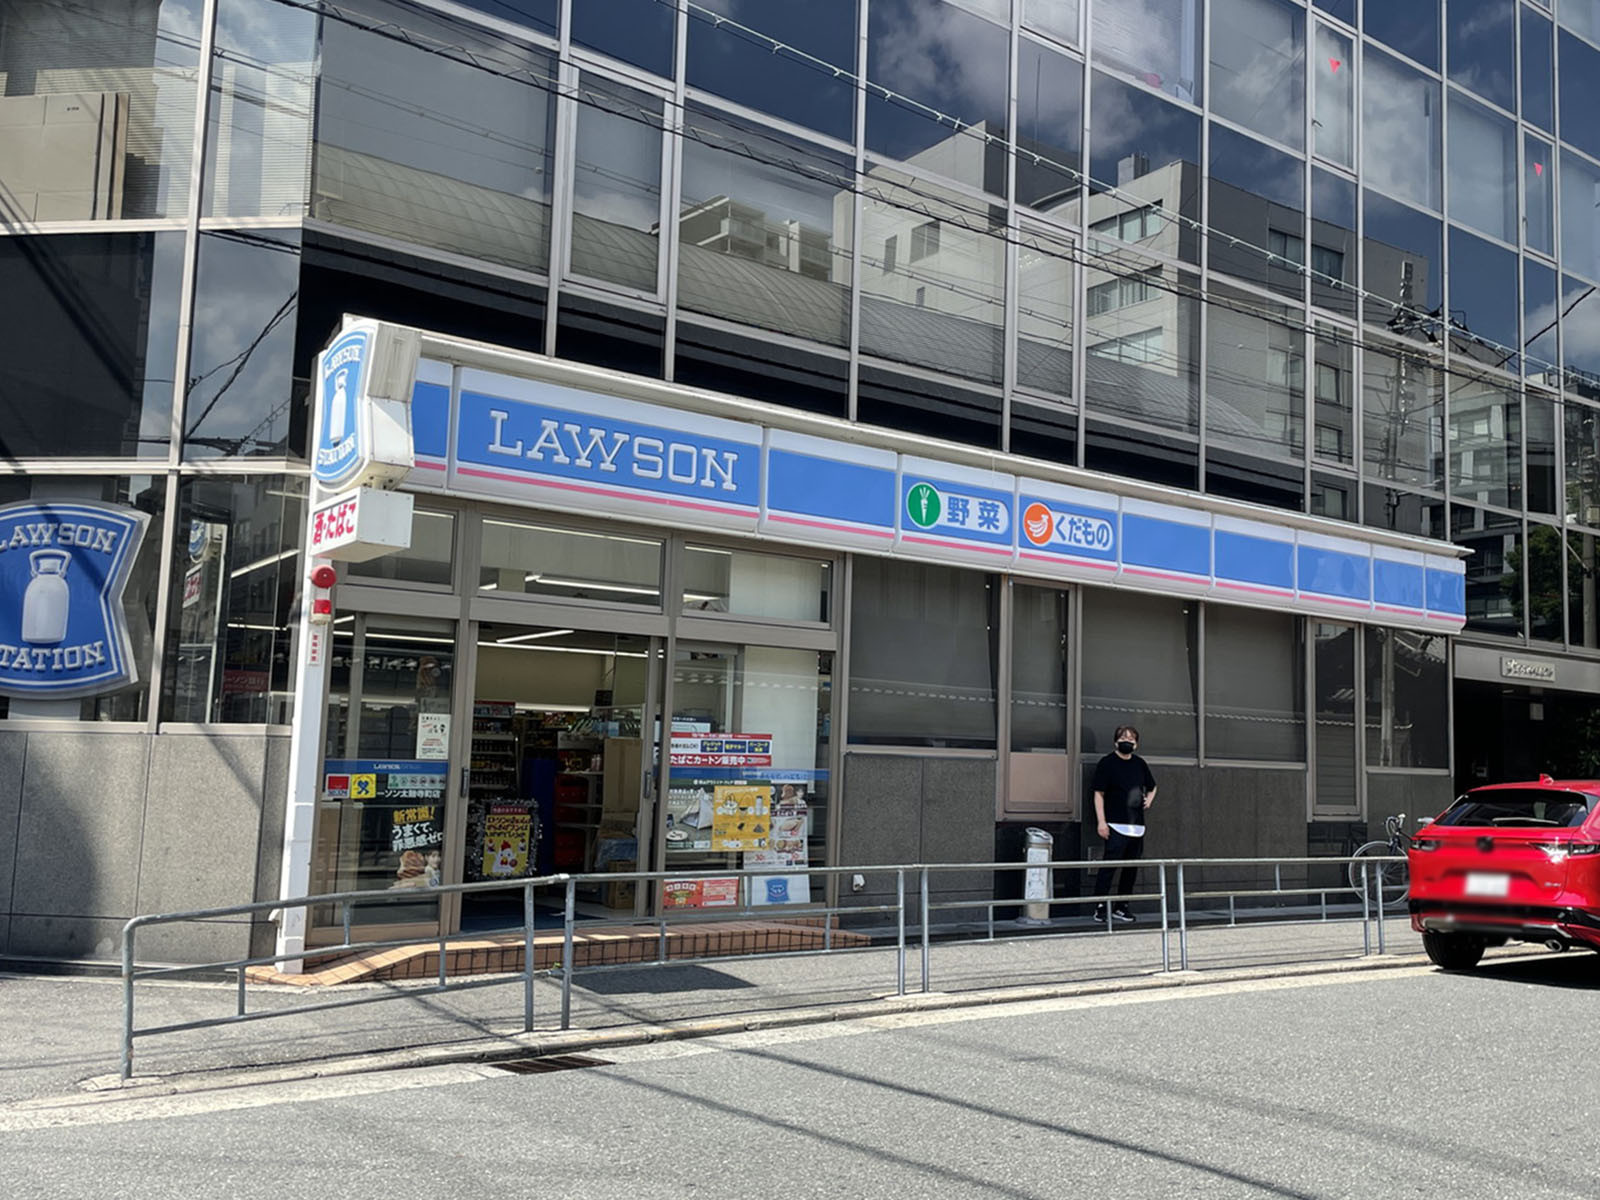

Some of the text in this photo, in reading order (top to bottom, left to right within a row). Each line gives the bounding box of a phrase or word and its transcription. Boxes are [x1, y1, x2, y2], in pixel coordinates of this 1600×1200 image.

[488, 409, 738, 491] LAWSON
[947, 496, 1000, 530] 野菜
[1055, 516, 1110, 548] くだもの
[0, 641, 105, 671] TATION
